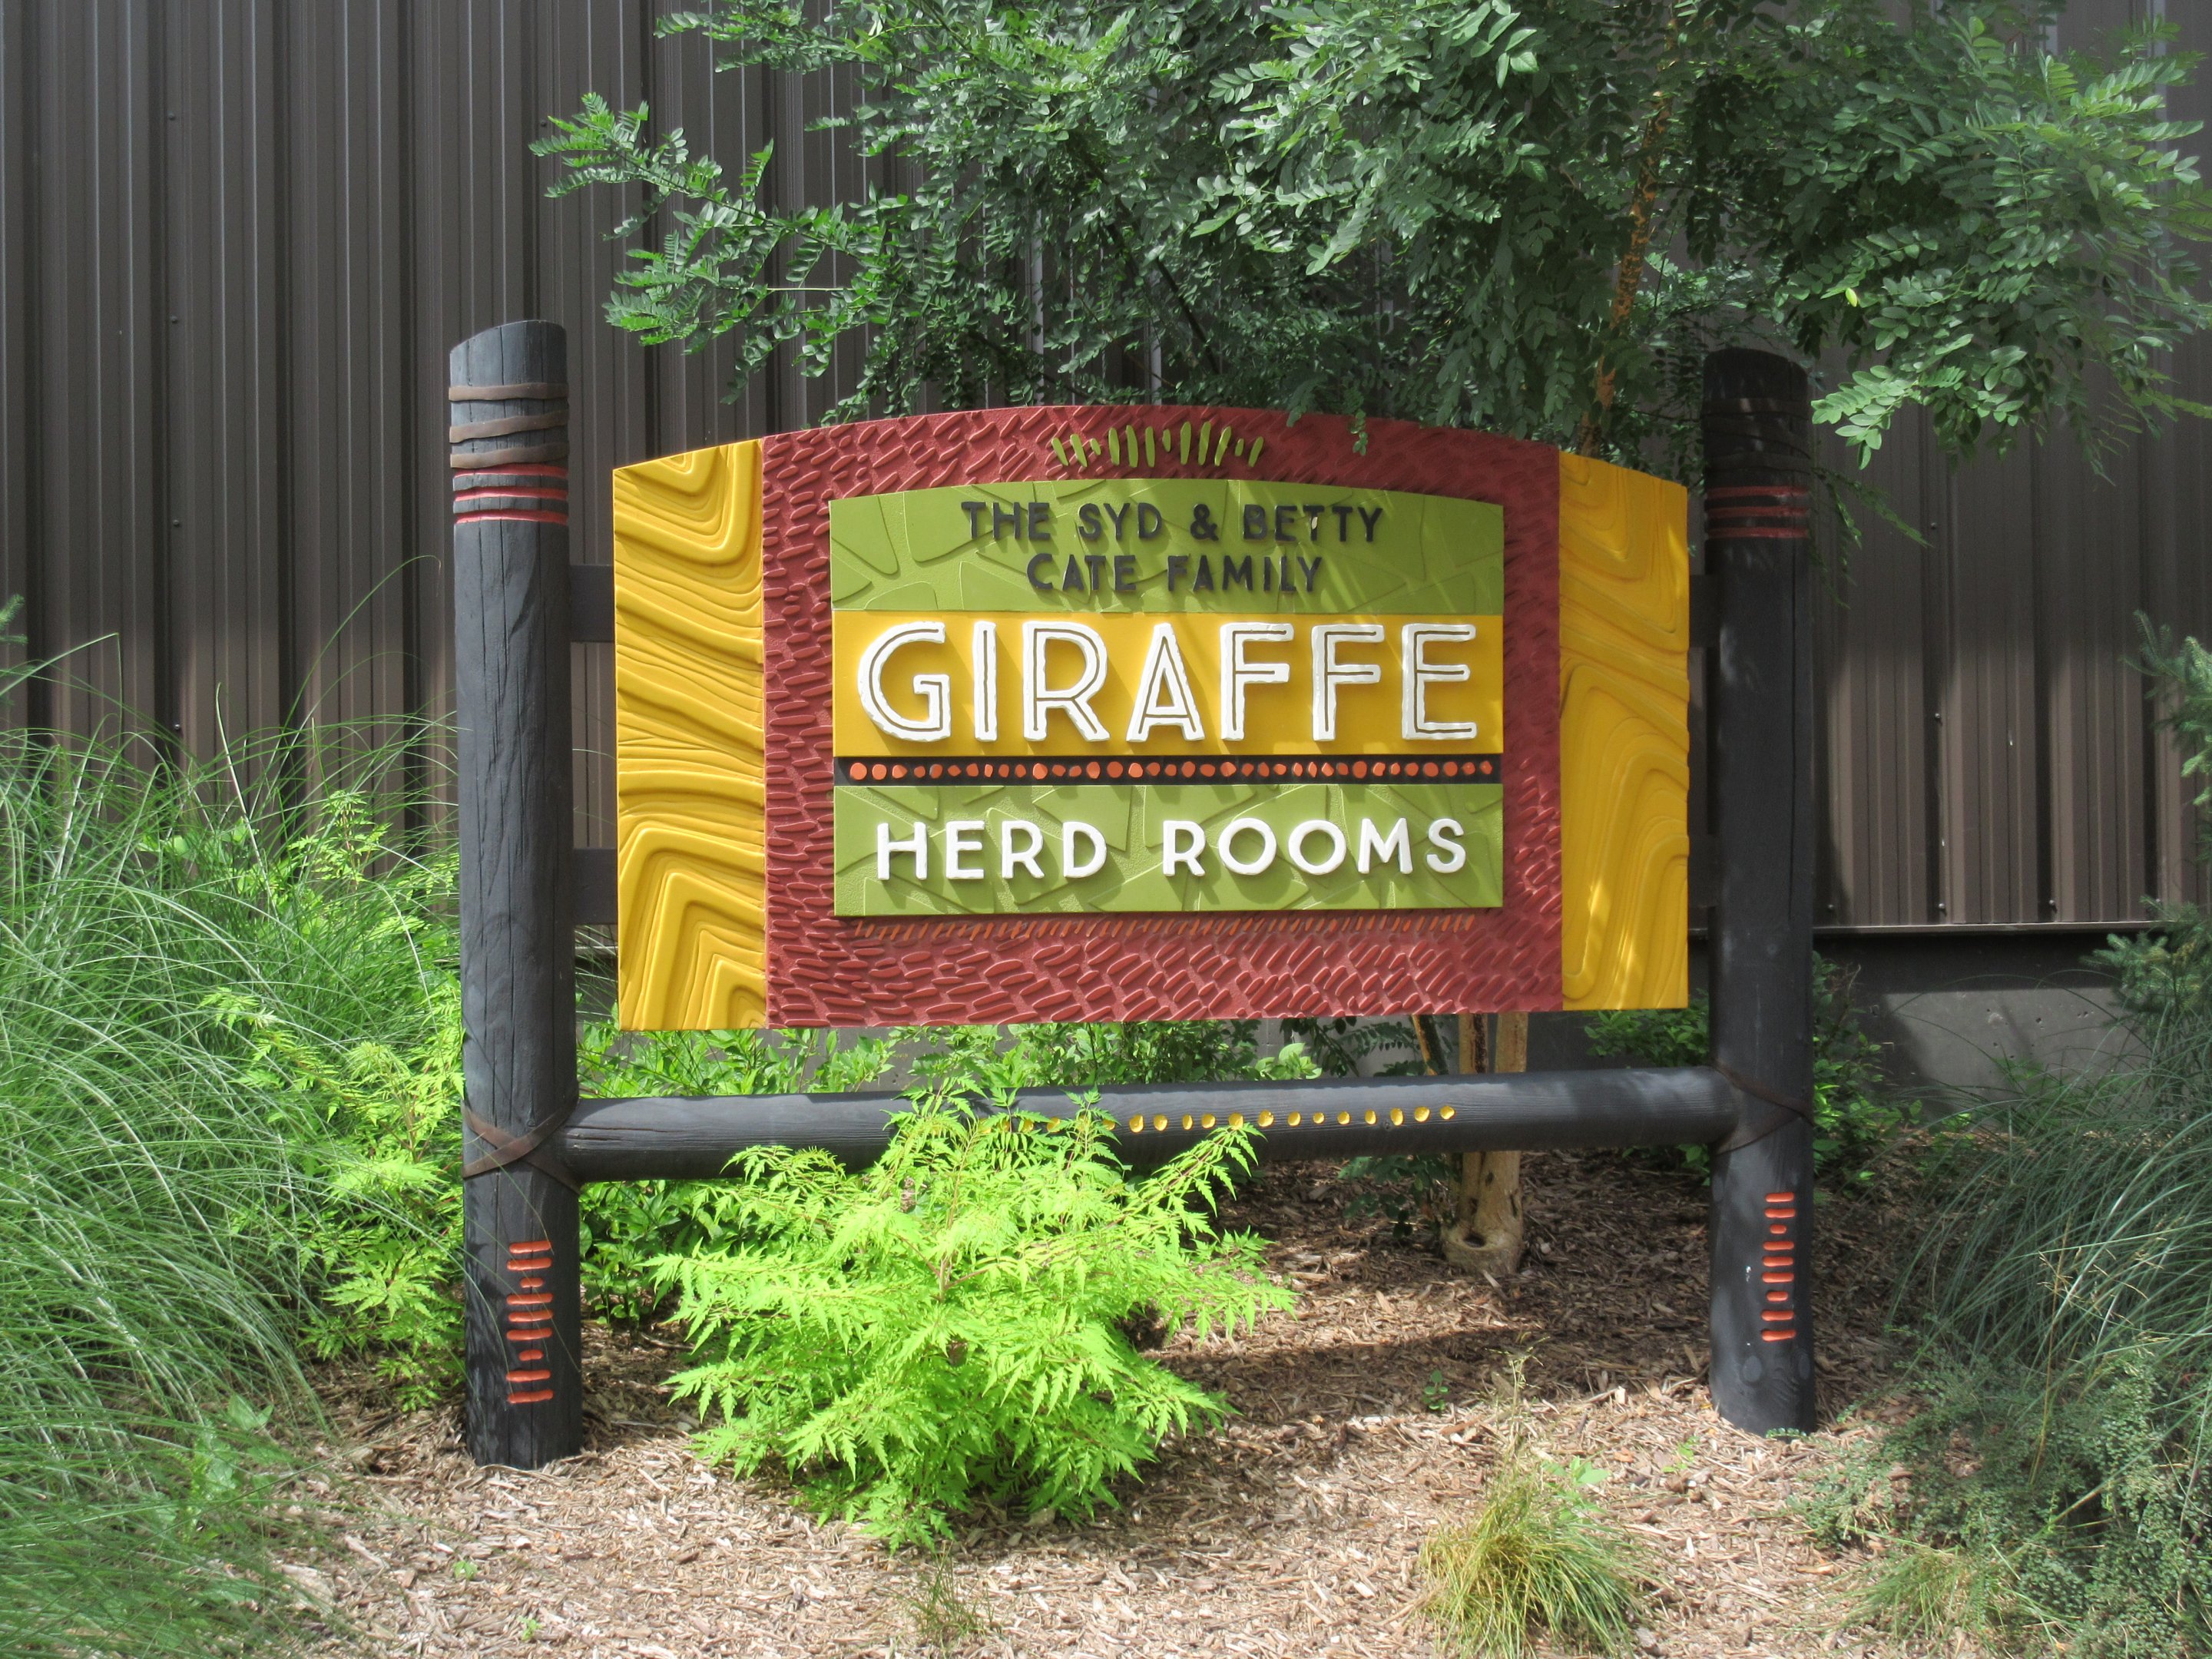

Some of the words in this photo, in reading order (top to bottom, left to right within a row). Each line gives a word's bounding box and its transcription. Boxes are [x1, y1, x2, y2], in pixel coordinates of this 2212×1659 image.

[960, 502, 1051, 540] THE
[1078, 502, 1163, 541] SYD
[1190, 503, 1219, 541] &
[1242, 503, 1383, 542] BETTY
[1026, 553, 1137, 593] CATE
[1167, 554, 1323, 594] FAMILY
[857, 620, 1478, 743] GIRAFFE
[876, 820, 1107, 881] HERD
[1162, 817, 1467, 877] ROOMS
